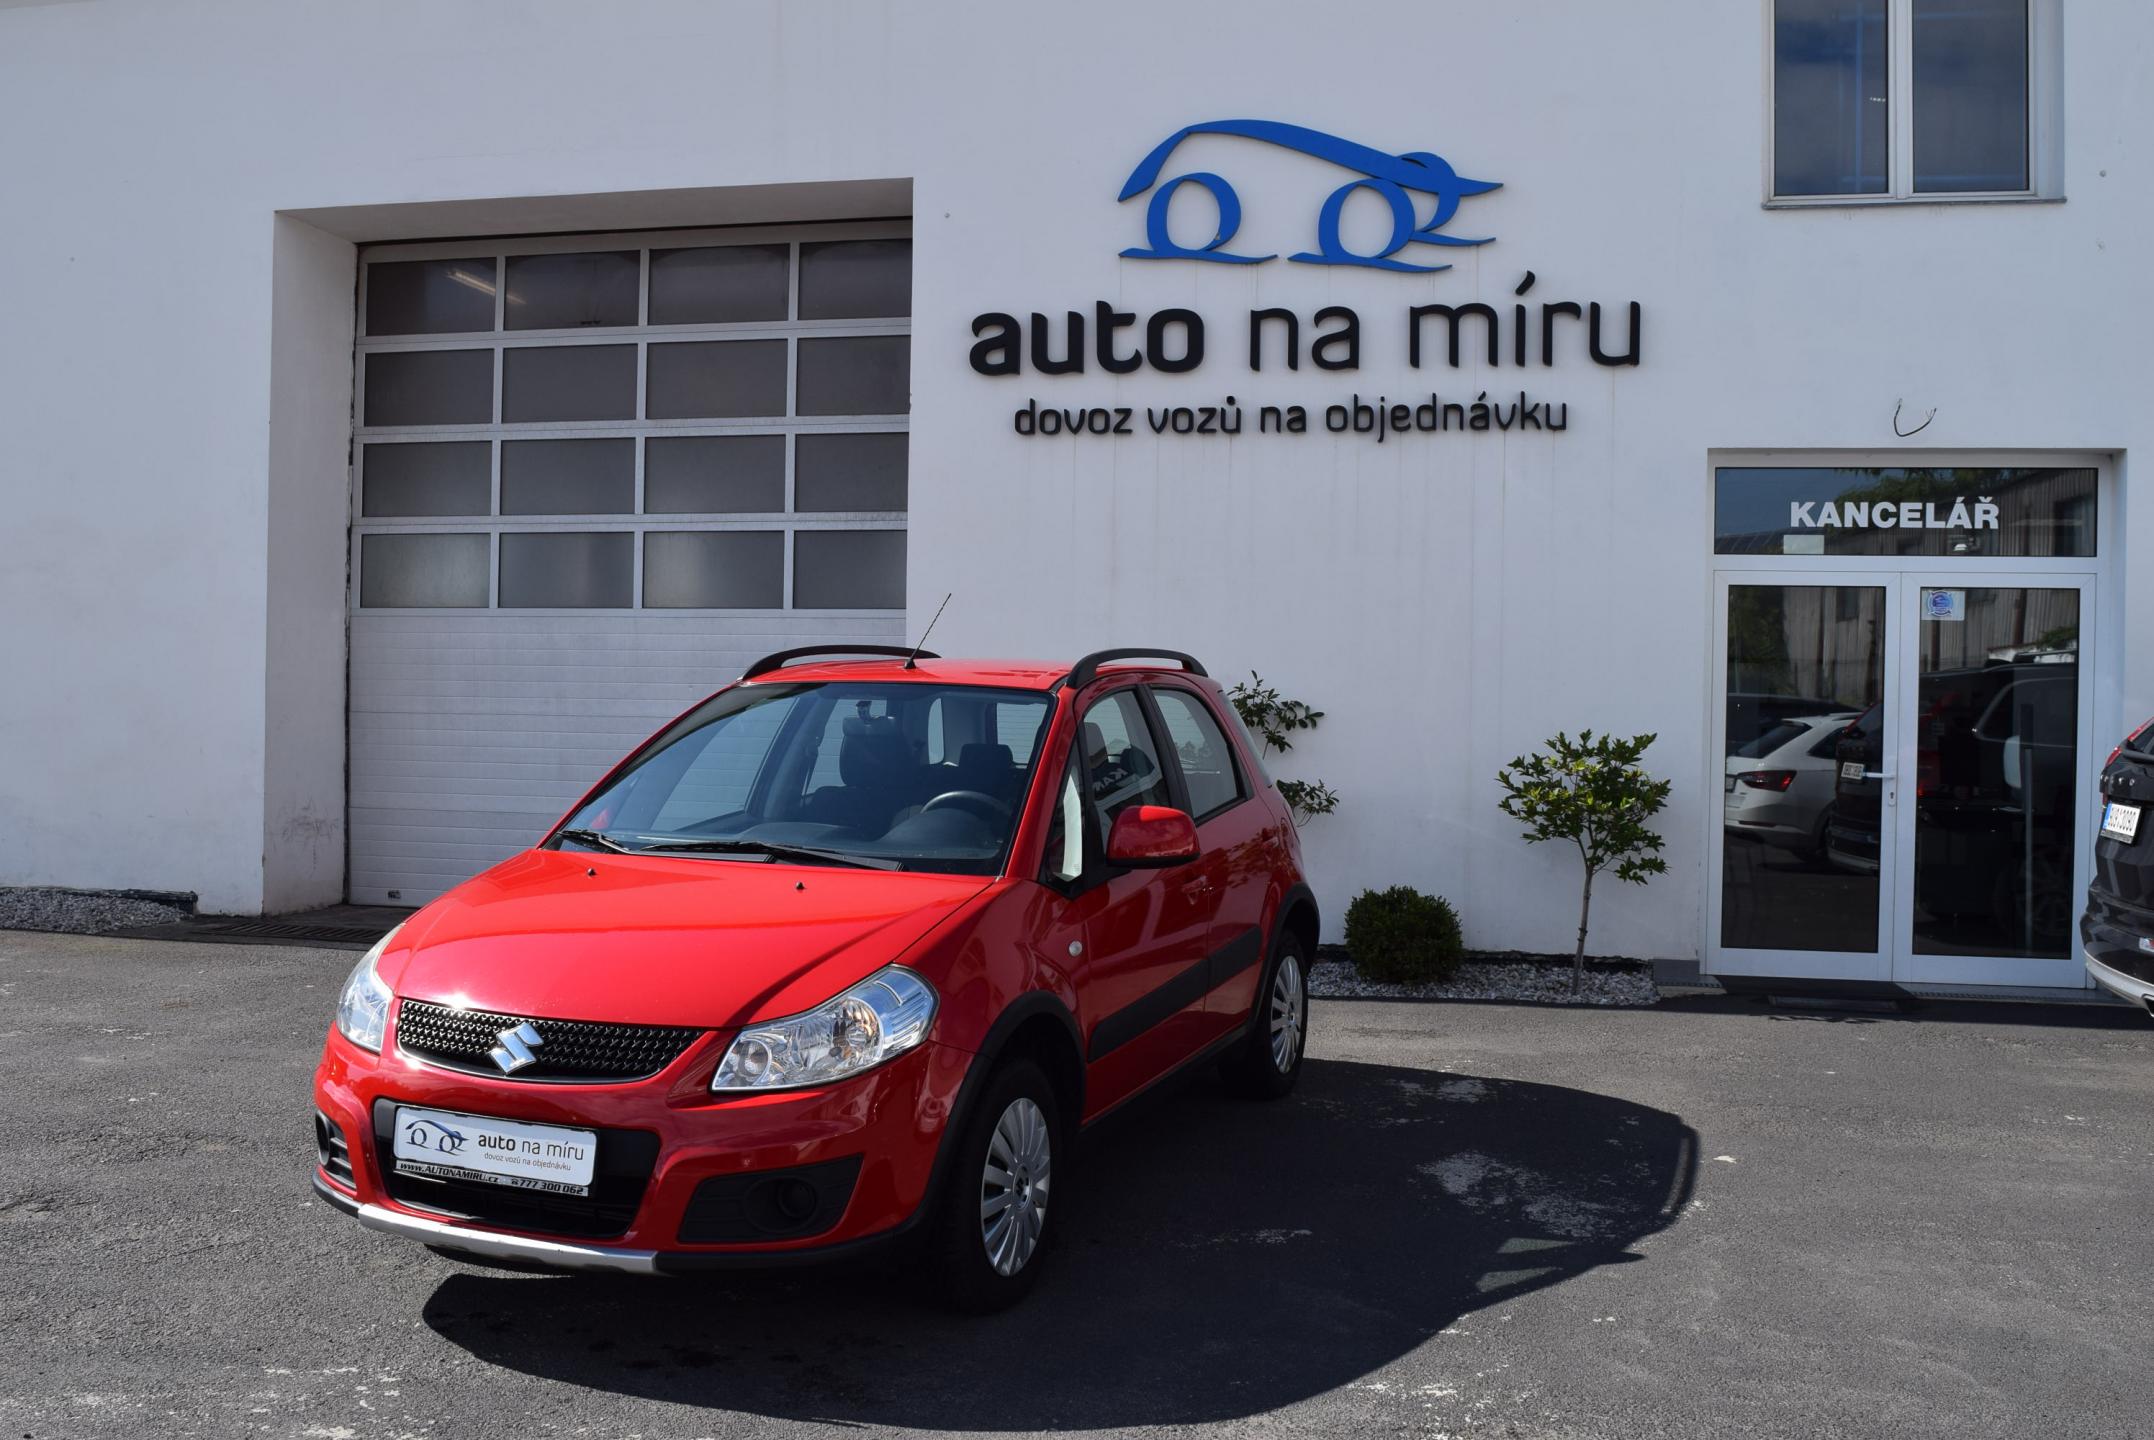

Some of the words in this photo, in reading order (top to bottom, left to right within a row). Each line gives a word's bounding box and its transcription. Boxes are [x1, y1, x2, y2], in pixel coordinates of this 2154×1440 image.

[970, 301, 1204, 376] auto
[1250, 305, 1359, 372] na
[1408, 270, 1641, 368] míru
[1015, 398, 1133, 436] dovoz
[1147, 396, 1242, 435] vozů
[1260, 405, 1307, 434] na
[1325, 391, 1567, 443] objednávku
[1790, 496, 2000, 530] KANCELÁŘ
[478, 1134, 516, 1152] auto
[521, 1140, 541, 1155] na
[546, 1141, 584, 1161] míru
[484, 1151, 504, 1162] dovoz
[504, 1155, 521, 1164] vozů
[522, 1158, 532, 1166] na
[532, 1159, 571, 1171] objednávku
[400, 1163, 499, 1183] www.AUTONAMIRU.cz
[540, 1181, 561, 1192] 300
[562, 1185, 584, 1195] 062
